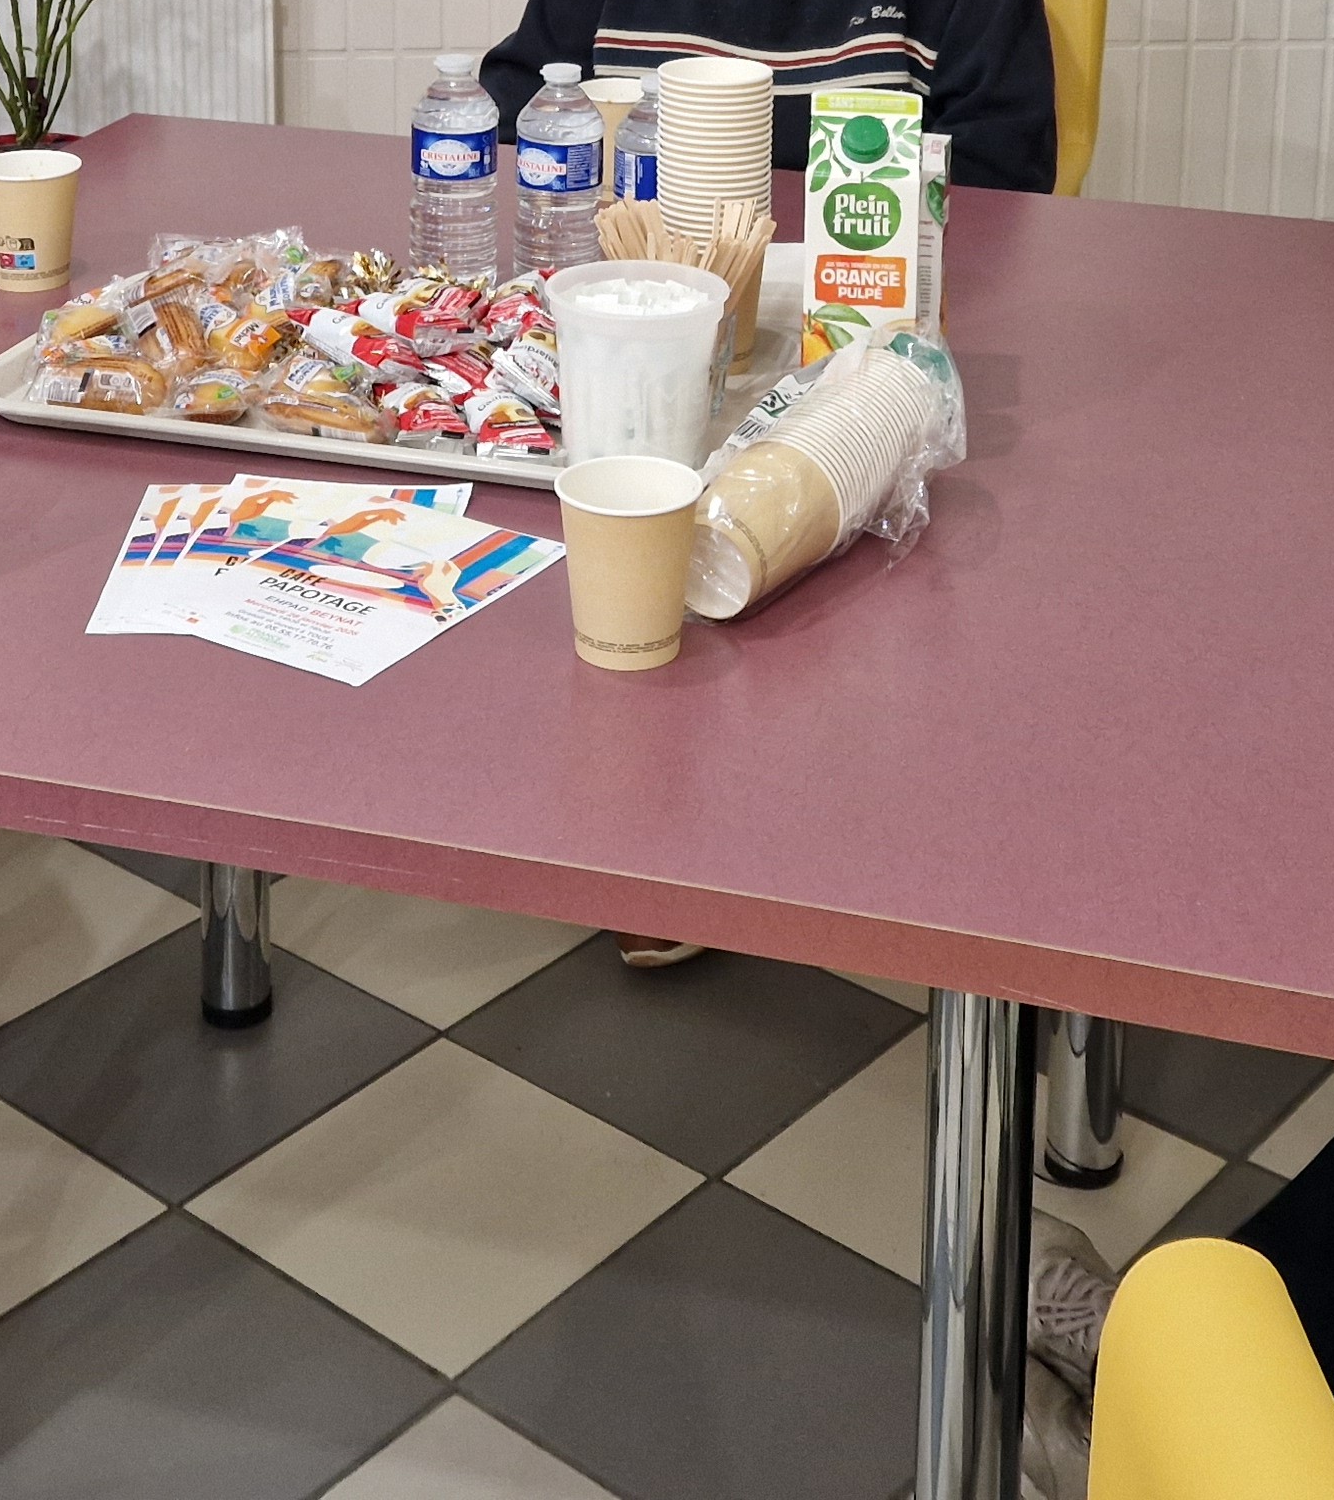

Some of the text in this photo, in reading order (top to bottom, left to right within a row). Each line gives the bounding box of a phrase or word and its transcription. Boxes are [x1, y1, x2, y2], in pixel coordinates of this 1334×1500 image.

[422, 150, 479, 162] CRISTALINE
[518, 157, 565, 174] RISTALINE
[834, 193, 889, 216] Plein
[833, 212, 892, 237] fruit
[820, 267, 901, 288] ORANGE
[837, 286, 884, 300] PULPÉ
[259, 576, 377, 616] PAPOTAGE
[265, 595, 364, 627] EHPAD BEYNAT
